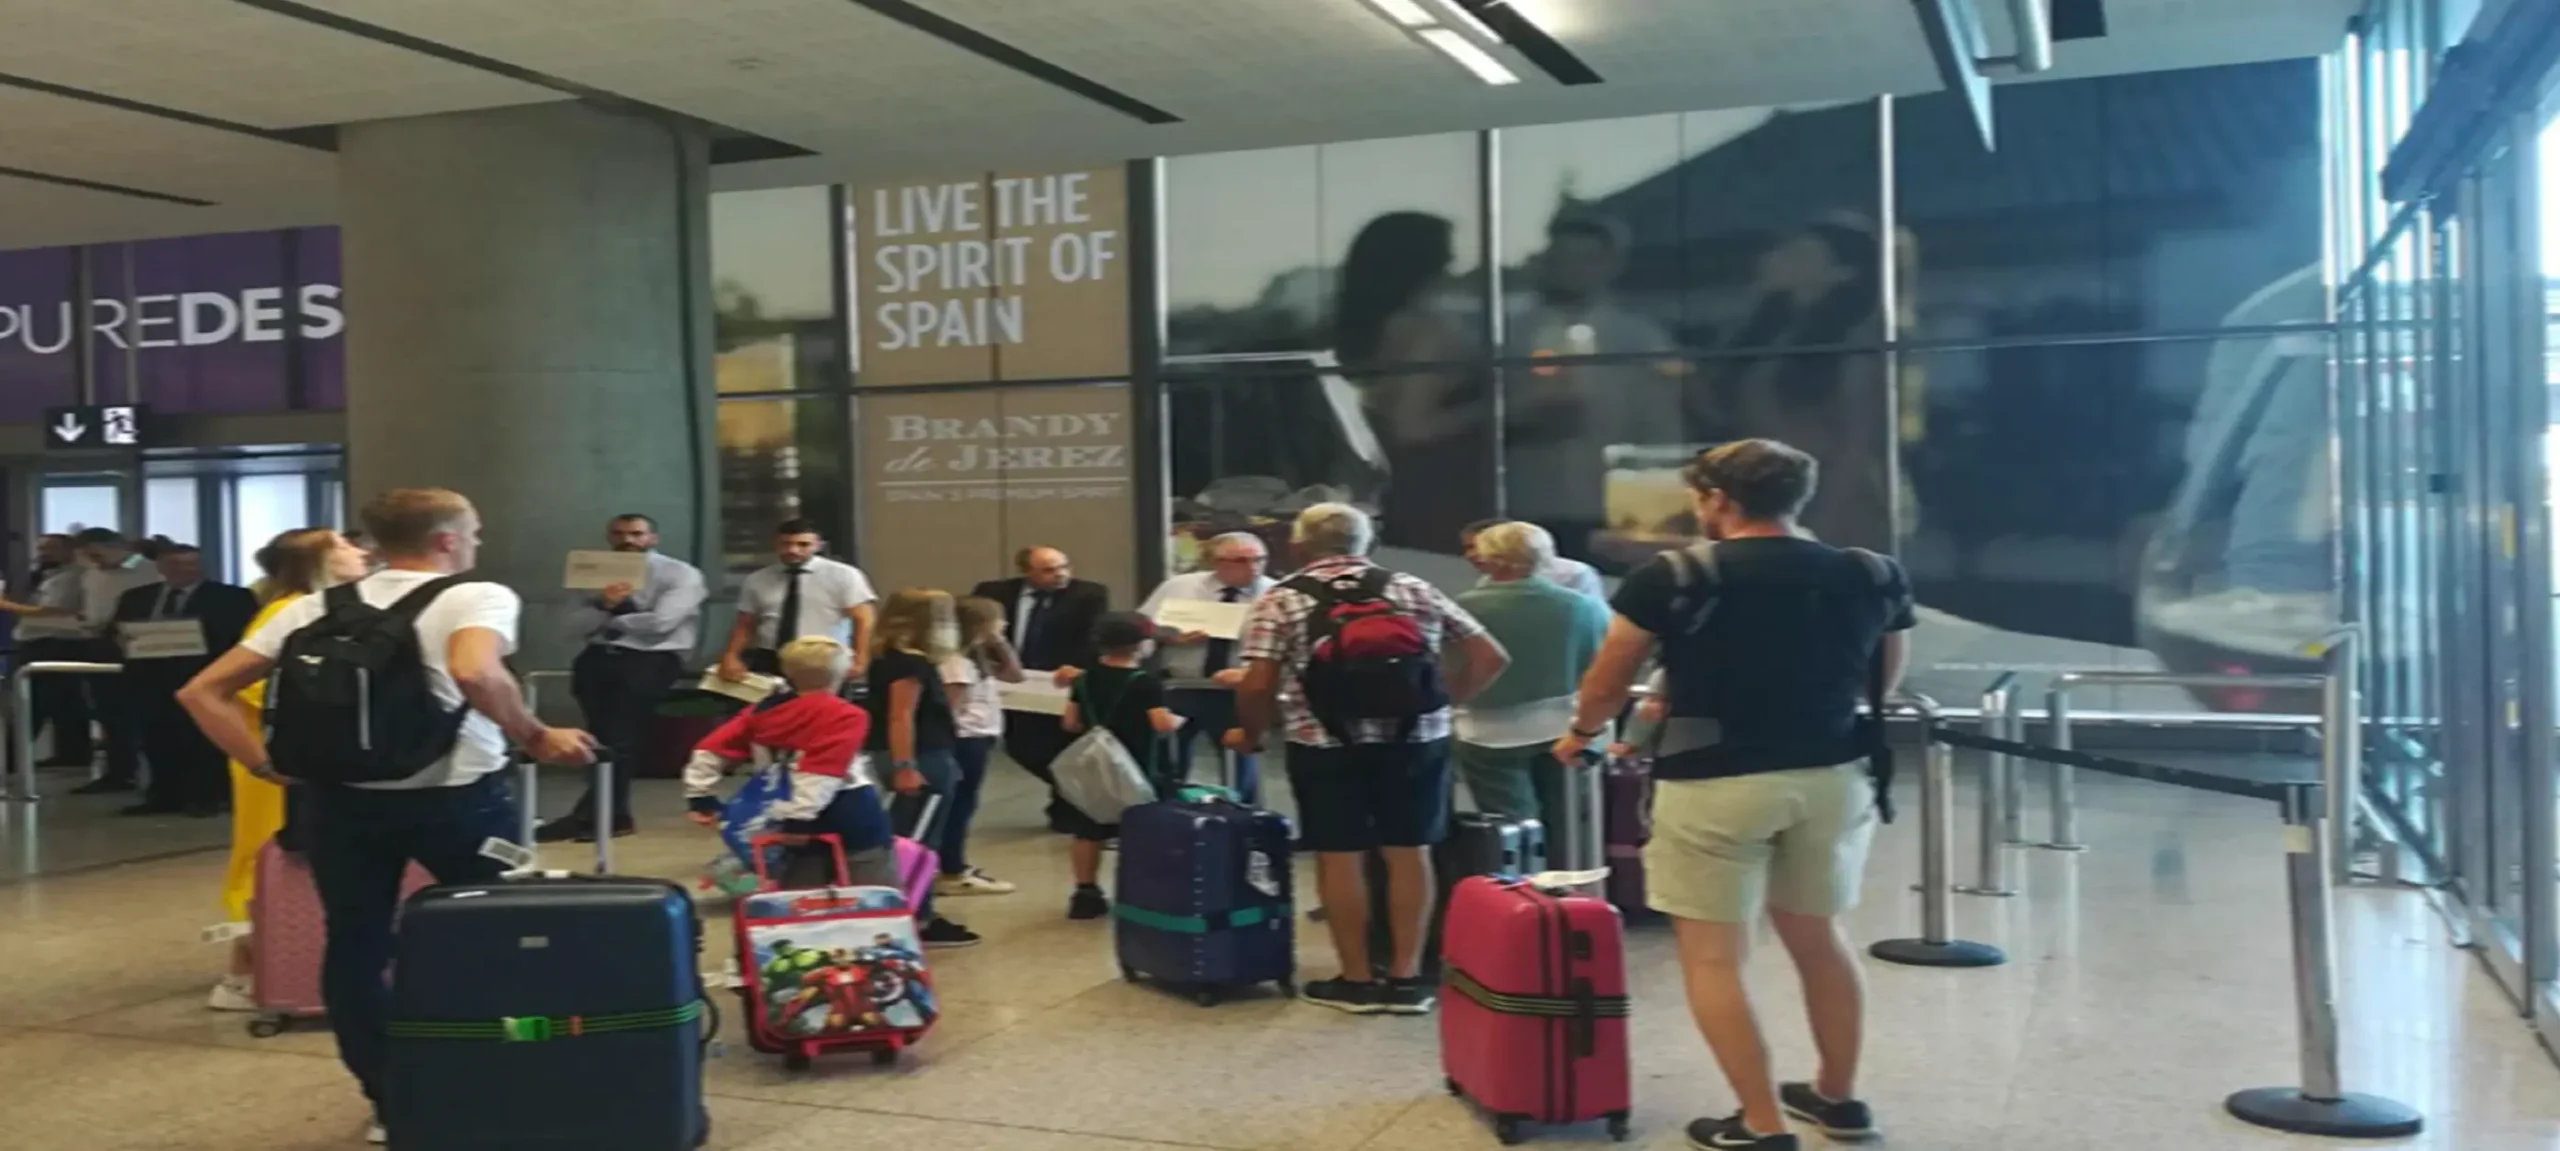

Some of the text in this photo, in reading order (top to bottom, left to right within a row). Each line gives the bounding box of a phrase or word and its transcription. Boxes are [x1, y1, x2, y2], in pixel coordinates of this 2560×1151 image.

[875, 172, 1091, 237] LIVE THE
[875, 231, 1117, 293] SPIRIT OF
[876, 296, 1024, 350] SPAIN
[886, 413, 1121, 441] BRANDY
[883, 444, 1125, 473] de JEREZ
